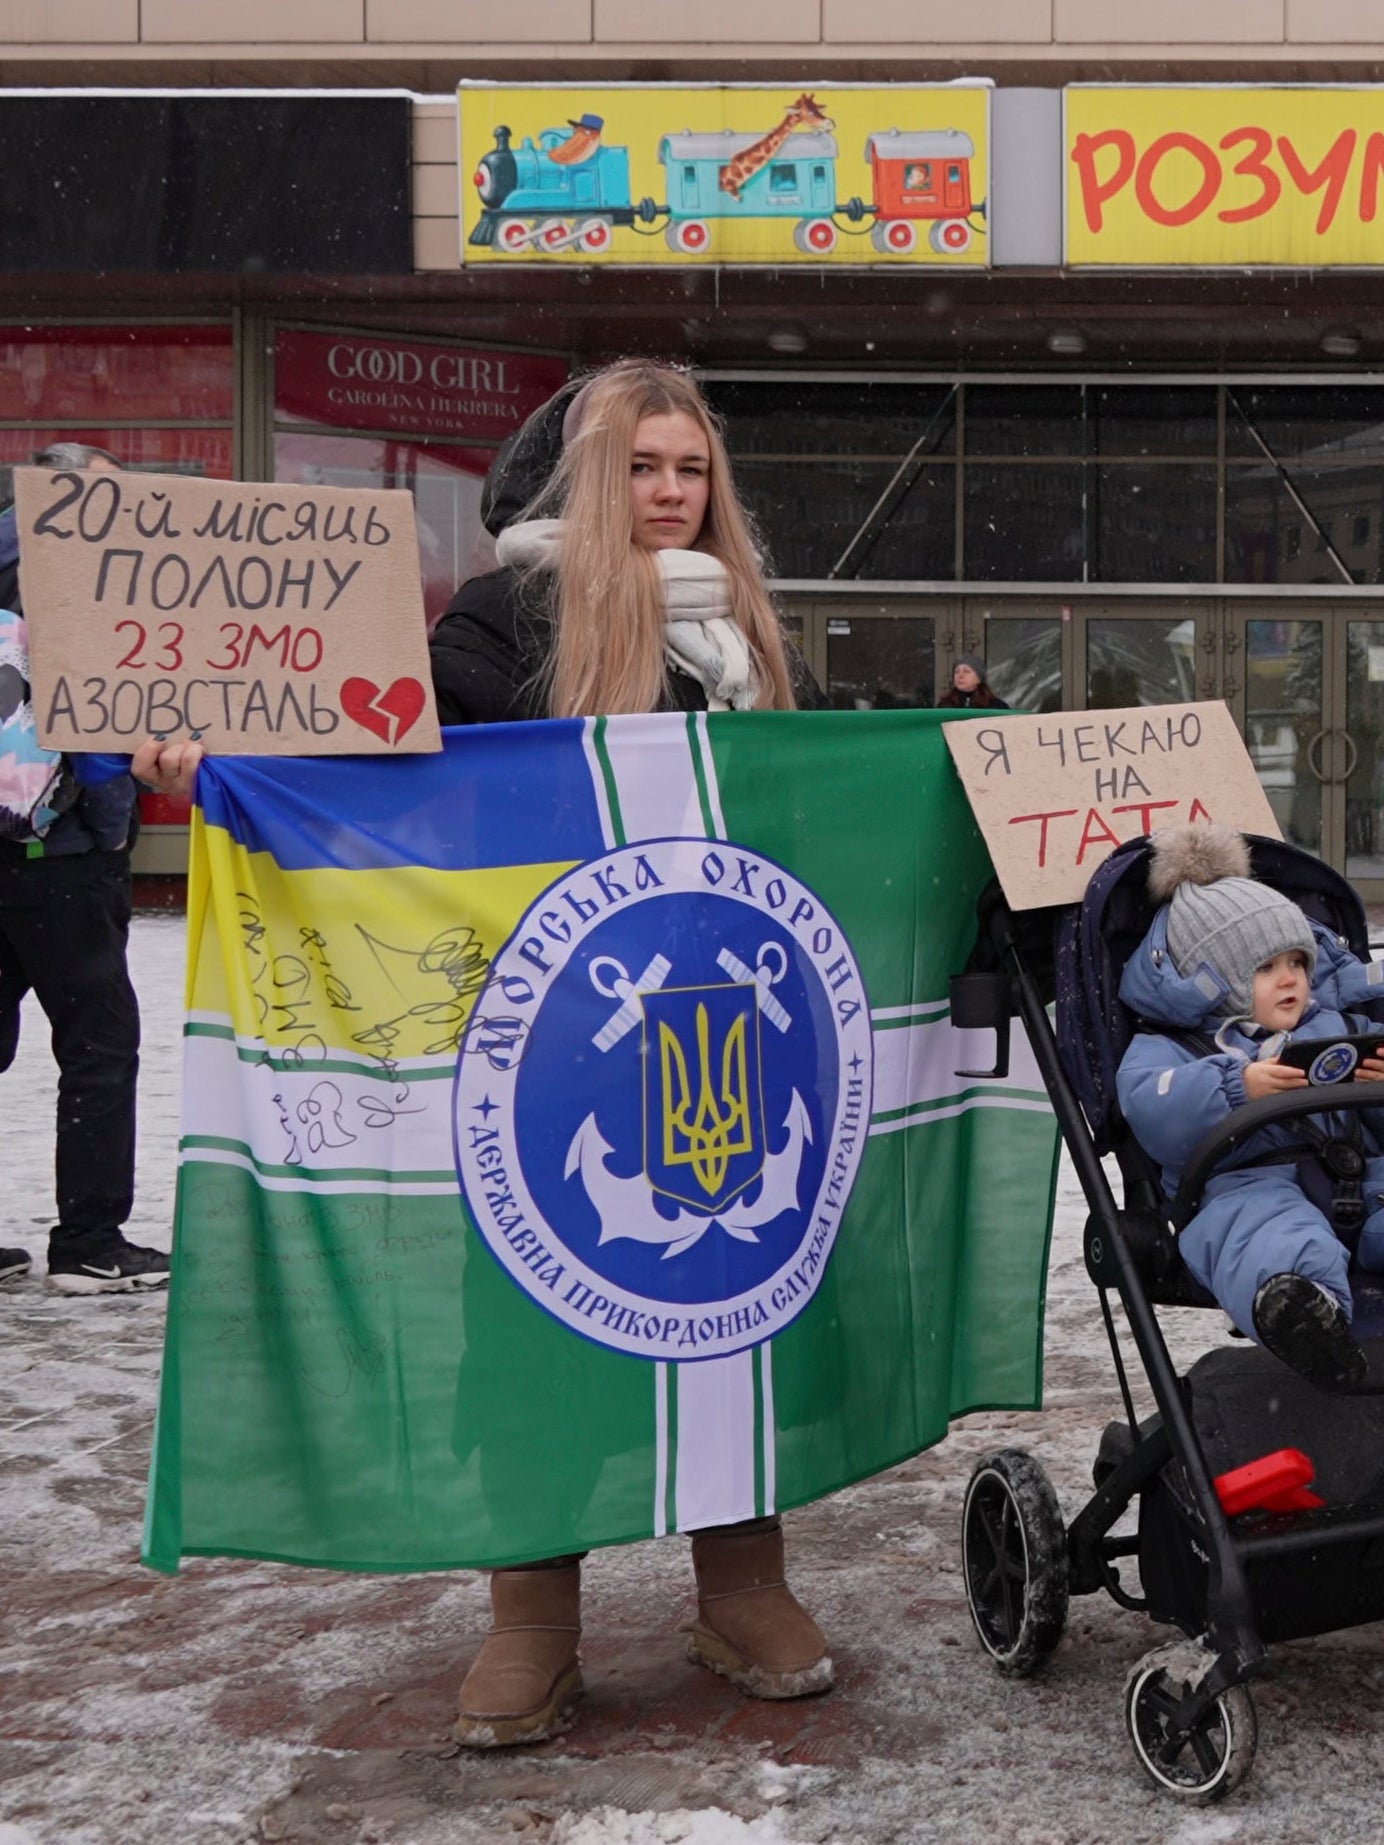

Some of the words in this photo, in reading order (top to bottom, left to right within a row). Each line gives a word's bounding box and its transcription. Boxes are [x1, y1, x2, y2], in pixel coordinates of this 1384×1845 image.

[328, 345, 423, 384] GOOD
[430, 354, 520, 394] GIRL
[328, 387, 425, 411] CAROLINA
[95, 549, 363, 610] ПОЛОНУ
[114, 620, 185, 672] 23
[46, 675, 340, 735] АЗОВСТАЛЬ
[976, 729, 1012, 776] Я
[1037, 712, 1202, 767] ЧЕКАЮ
[1095, 764, 1152, 802] НА
[701, 852, 862, 1030] ОХОРОНА
[562, 1279, 770, 1347] ПРИКОРДОННА
